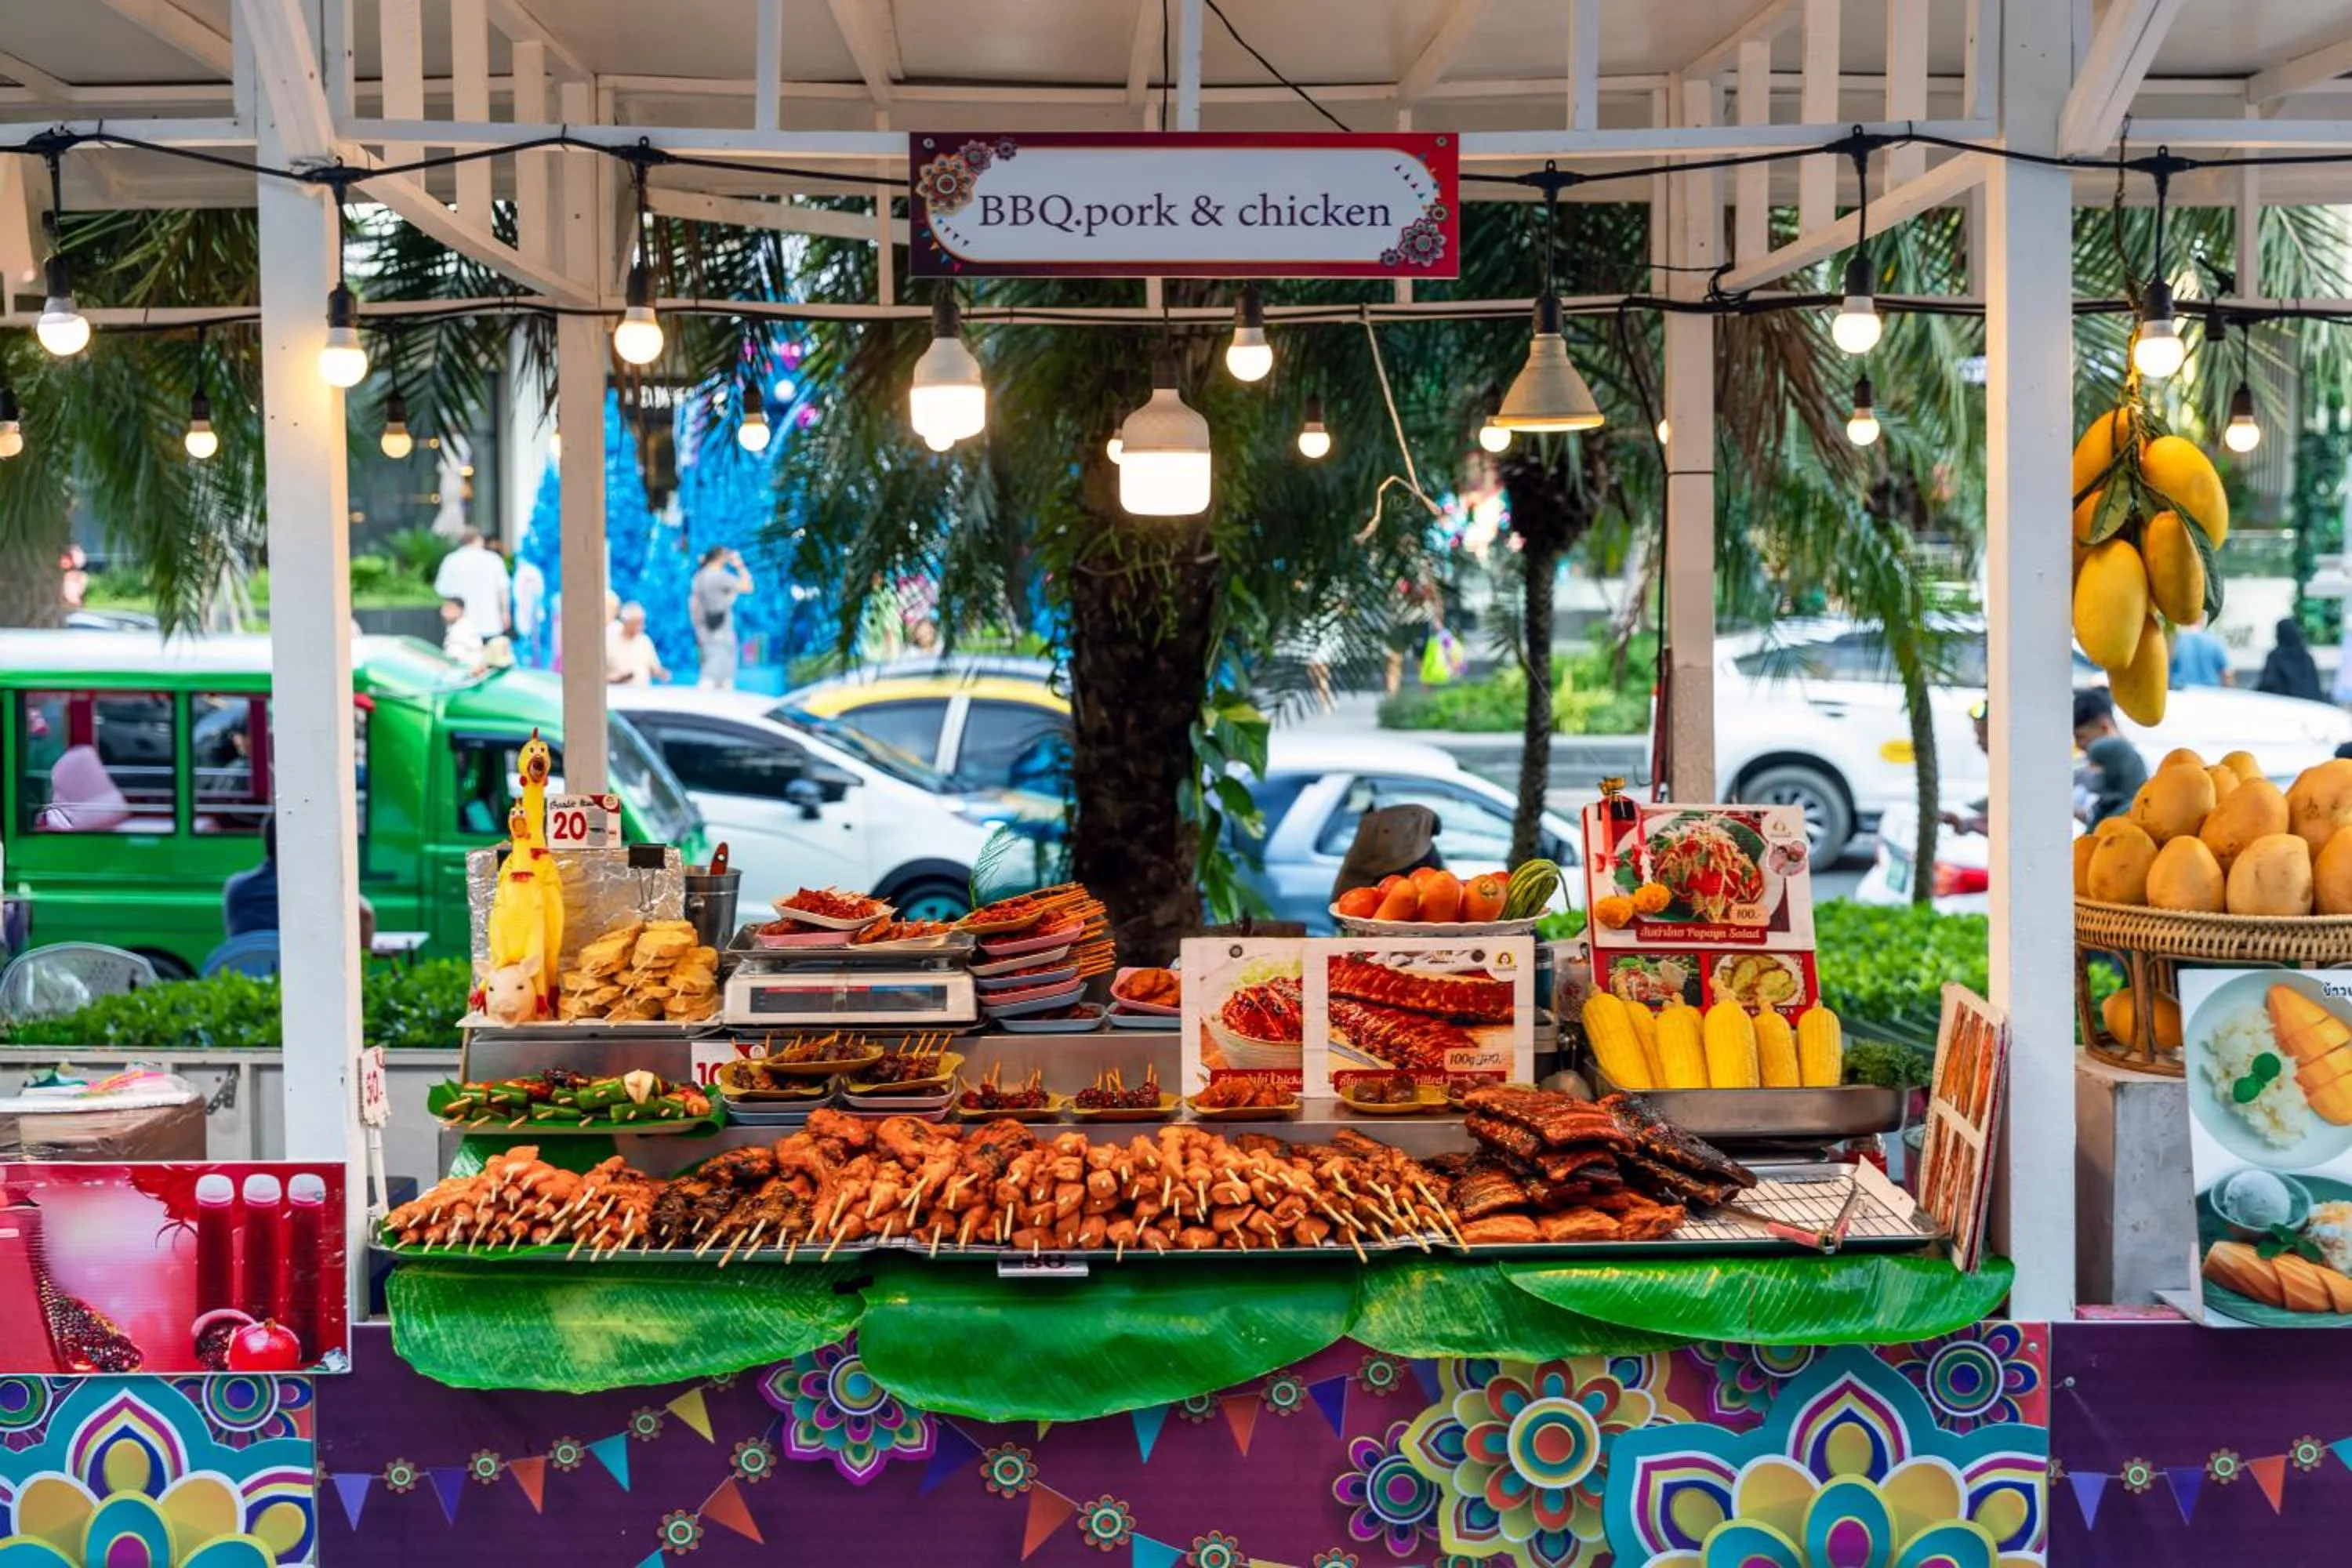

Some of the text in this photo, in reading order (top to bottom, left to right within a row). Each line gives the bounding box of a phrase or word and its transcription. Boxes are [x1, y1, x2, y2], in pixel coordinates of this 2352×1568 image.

[979, 193, 1393, 236] BBQ.pork & chicken
[554, 811, 587, 840] 20
[1687, 927, 1726, 940] Papaya
[1729, 928, 1761, 939] Salad
